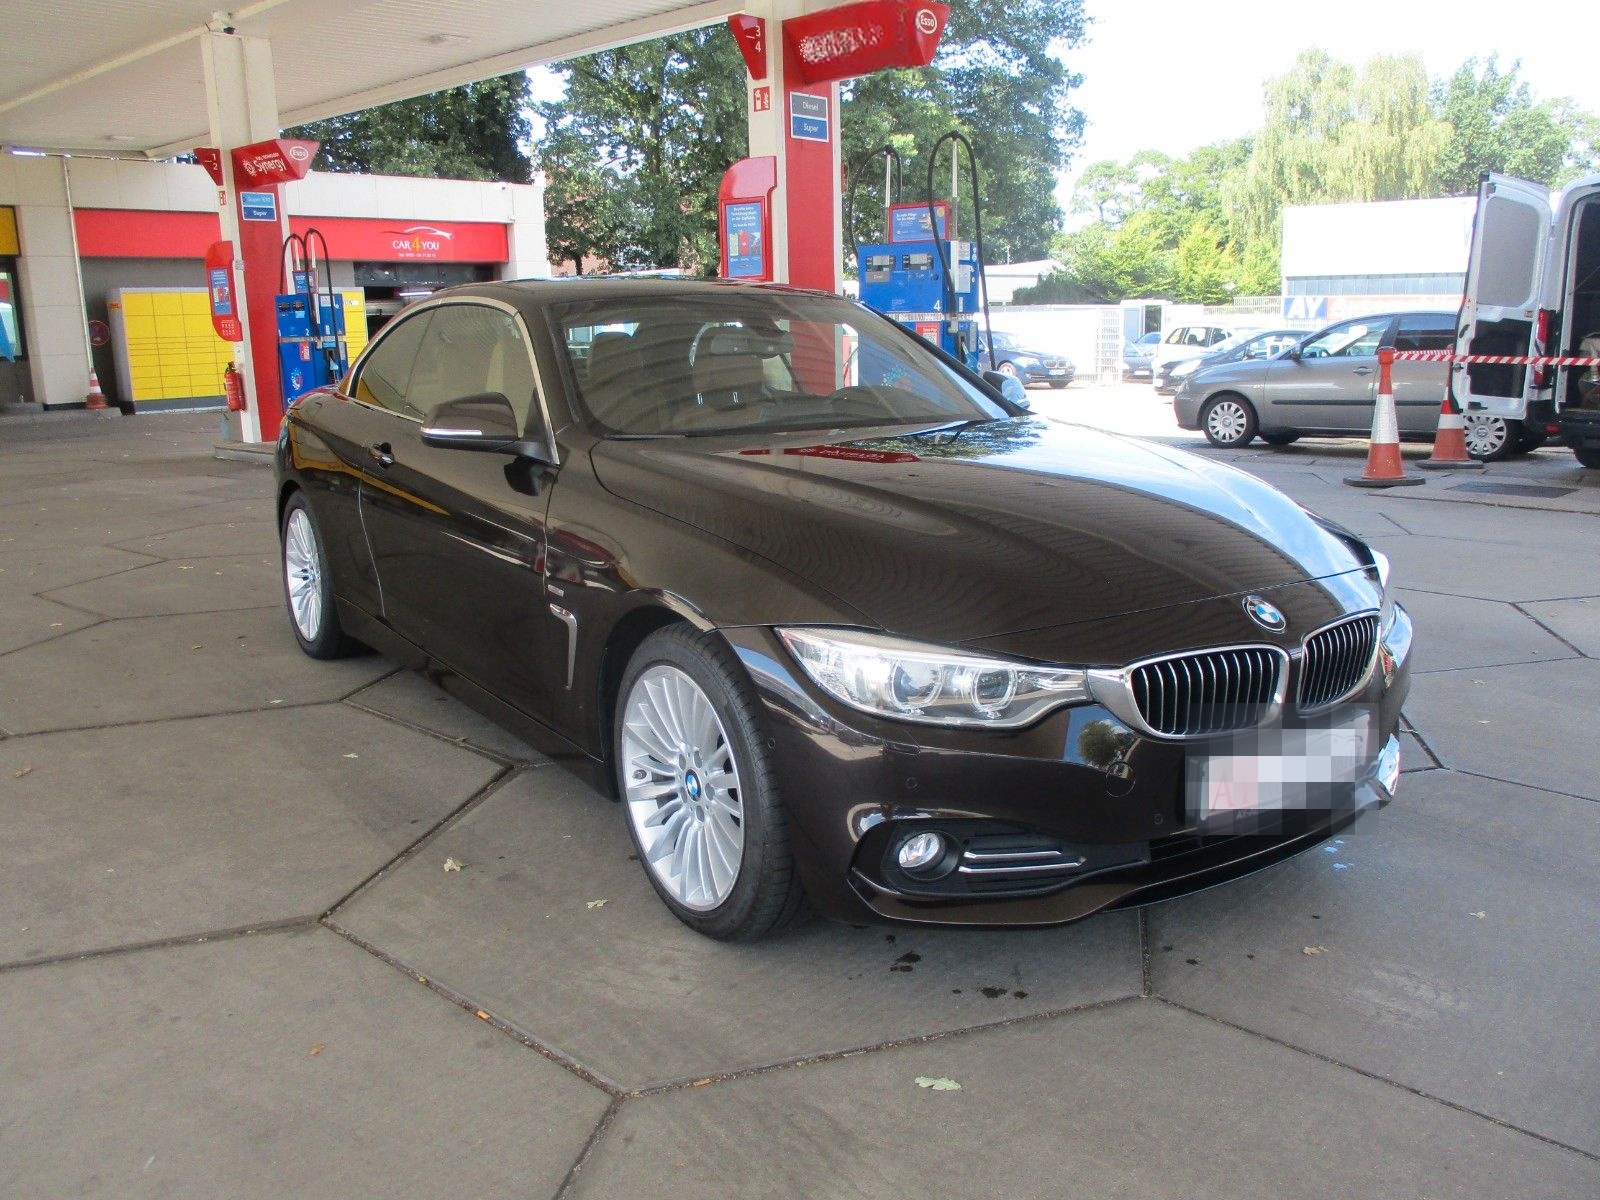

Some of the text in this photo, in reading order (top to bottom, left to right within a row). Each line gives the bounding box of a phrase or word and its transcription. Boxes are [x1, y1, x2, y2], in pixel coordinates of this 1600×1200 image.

[919, 15, 935, 28] Esso
[754, 25, 761, 37] 3
[754, 41, 762, 53] 4
[802, 101, 819, 112] Diesel
[803, 123, 819, 134] Super
[211, 153, 217, 161] 1
[212, 162, 219, 171] 2
[253, 158, 287, 175] Synergy
[392, 236, 440, 252] CAR 4 YOU
[933, 299, 942, 312] 4
[1285, 297, 1325, 320] AY
